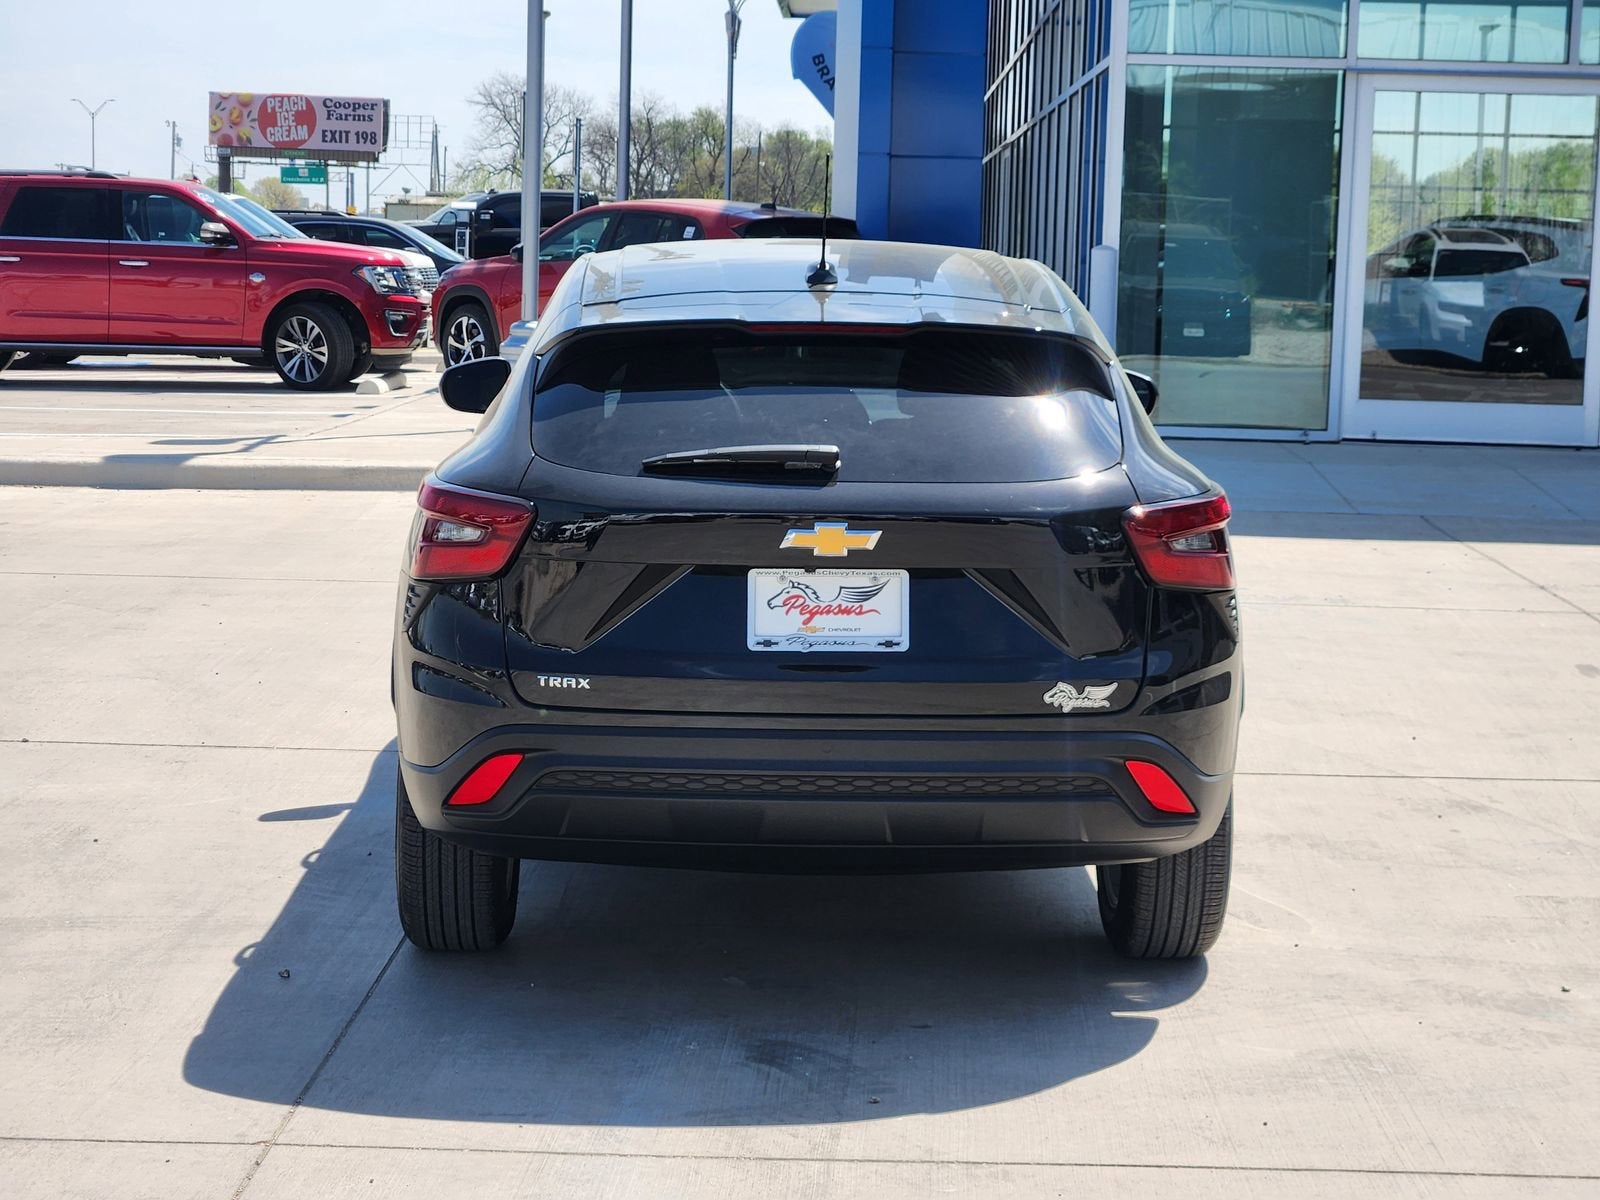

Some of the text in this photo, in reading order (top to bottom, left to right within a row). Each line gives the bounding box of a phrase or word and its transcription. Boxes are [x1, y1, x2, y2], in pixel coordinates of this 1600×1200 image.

[267, 96, 306, 113] PEACH
[322, 98, 378, 112] Cooper
[276, 112, 296, 127] ICE
[325, 110, 374, 122] Farms
[267, 125, 308, 141] CREAM
[321, 129, 377, 145] EXIT 198
[783, 594, 881, 626] Pegasus
[786, 636, 870, 650] Pegasus
[537, 675, 591, 689] TRAX
